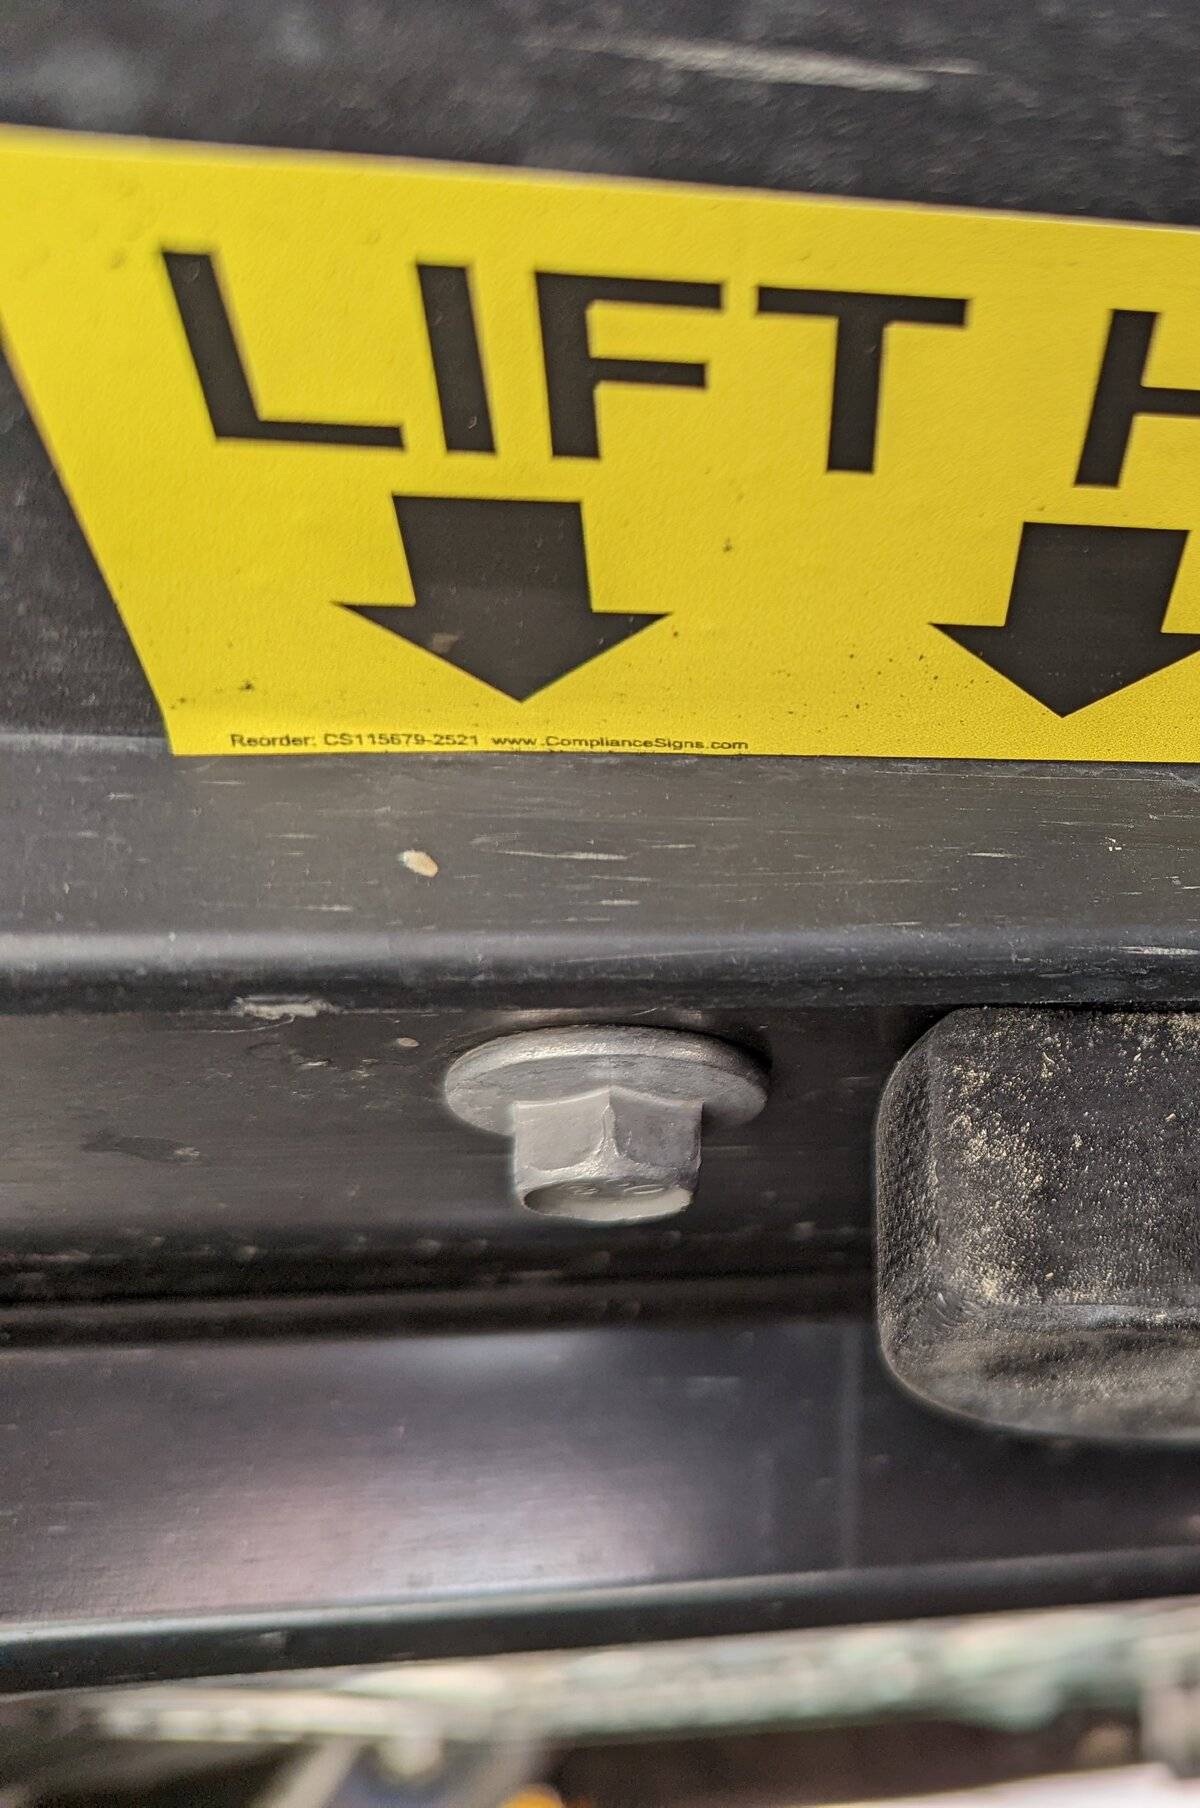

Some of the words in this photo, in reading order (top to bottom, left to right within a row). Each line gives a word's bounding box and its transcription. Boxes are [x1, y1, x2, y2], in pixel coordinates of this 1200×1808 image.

[162, 251, 968, 473] LIFT
[230, 733, 317, 748] Reorder:
[323, 732, 479, 747] CS115679-2521
[491, 735, 749, 750] www.ComplianceSigns.com
